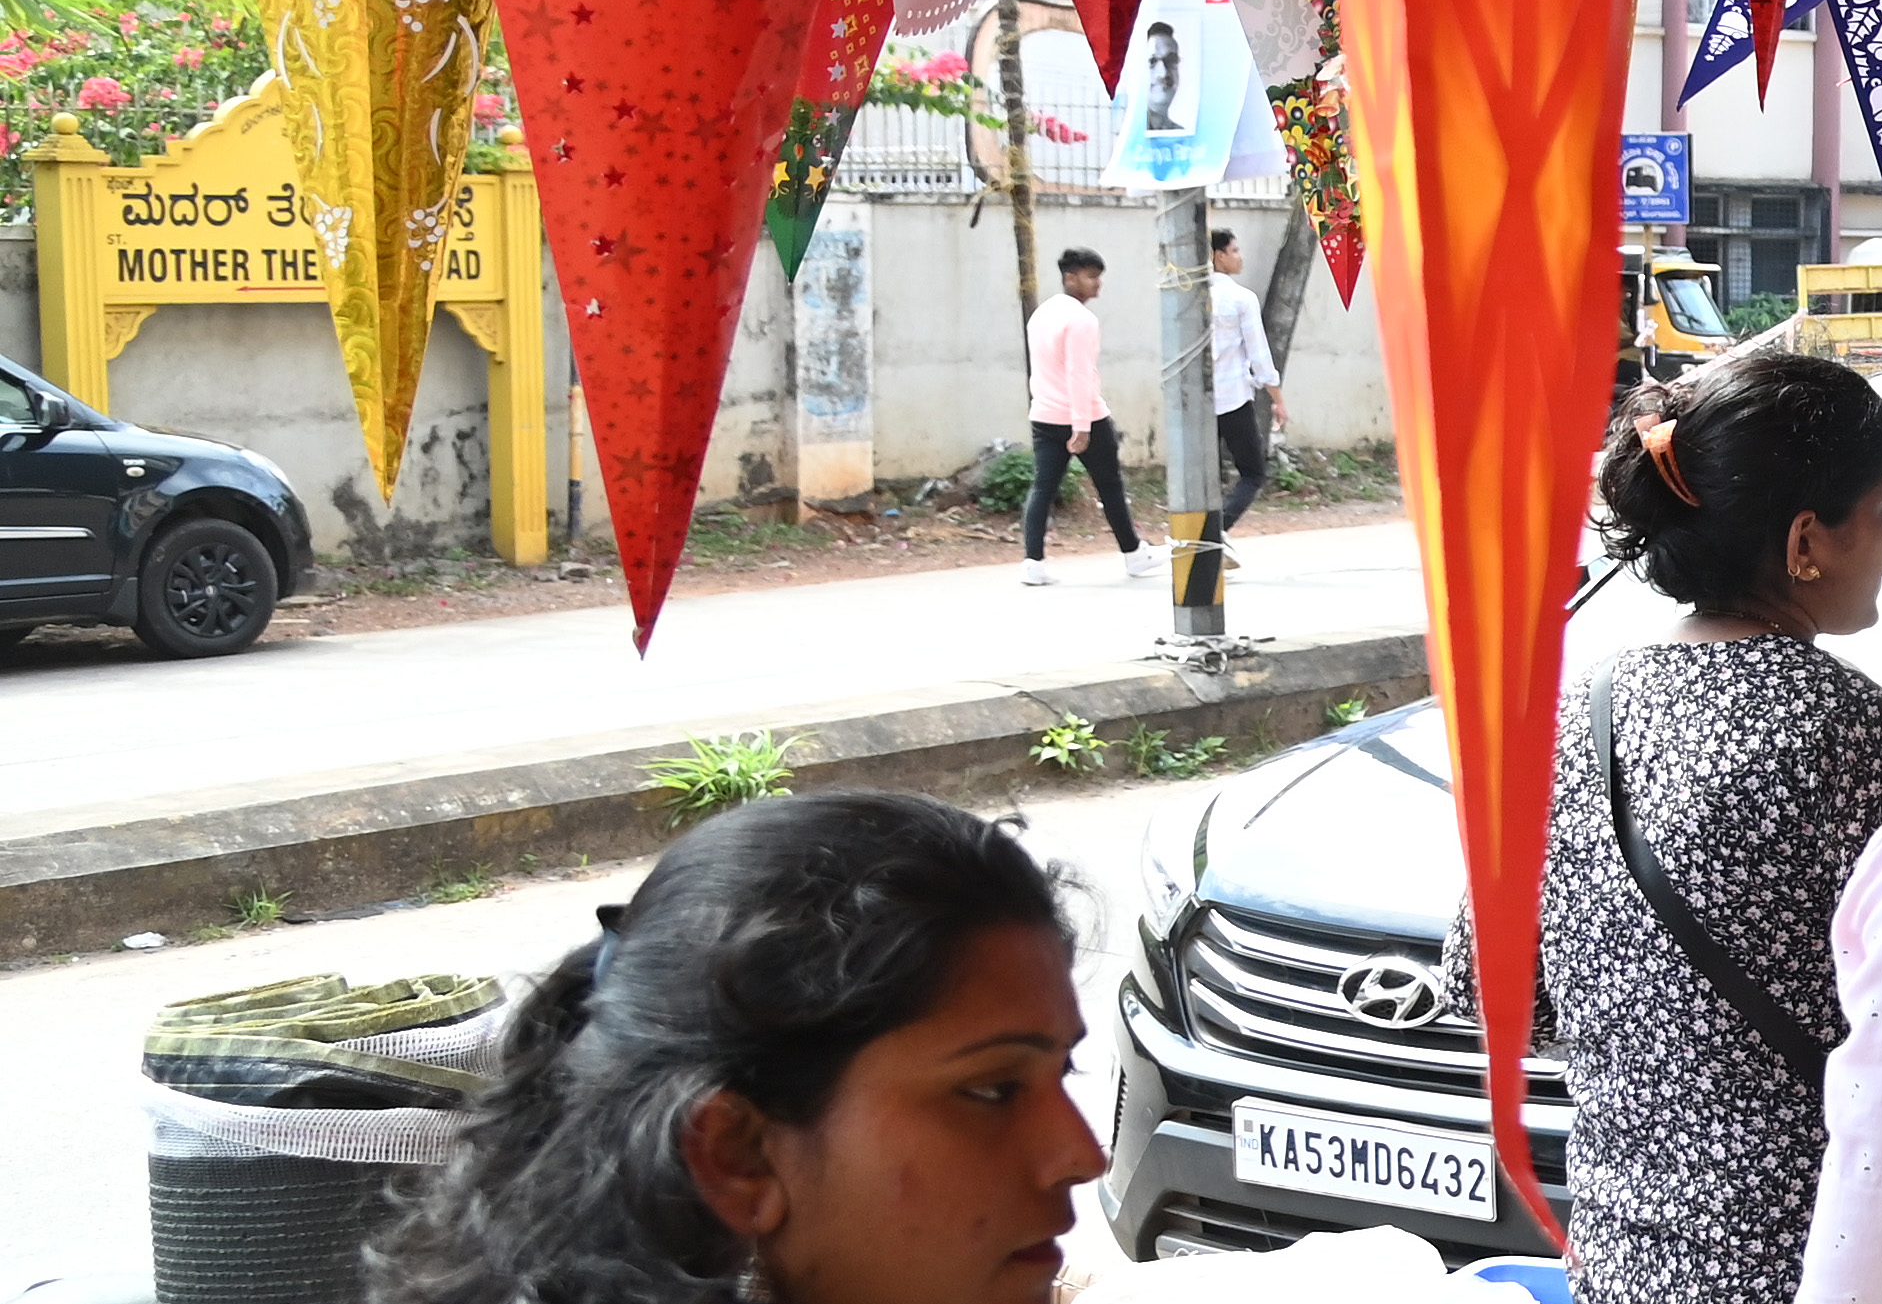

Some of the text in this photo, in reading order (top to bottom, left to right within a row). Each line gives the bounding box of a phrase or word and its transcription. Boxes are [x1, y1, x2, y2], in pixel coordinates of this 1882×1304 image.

[121, 180, 250, 228] ಮದರ್
[106, 233, 127, 246] ST.
[117, 248, 482, 283] MOTHER THE AD
[1259, 1123, 1487, 1203] KA53MD6432
